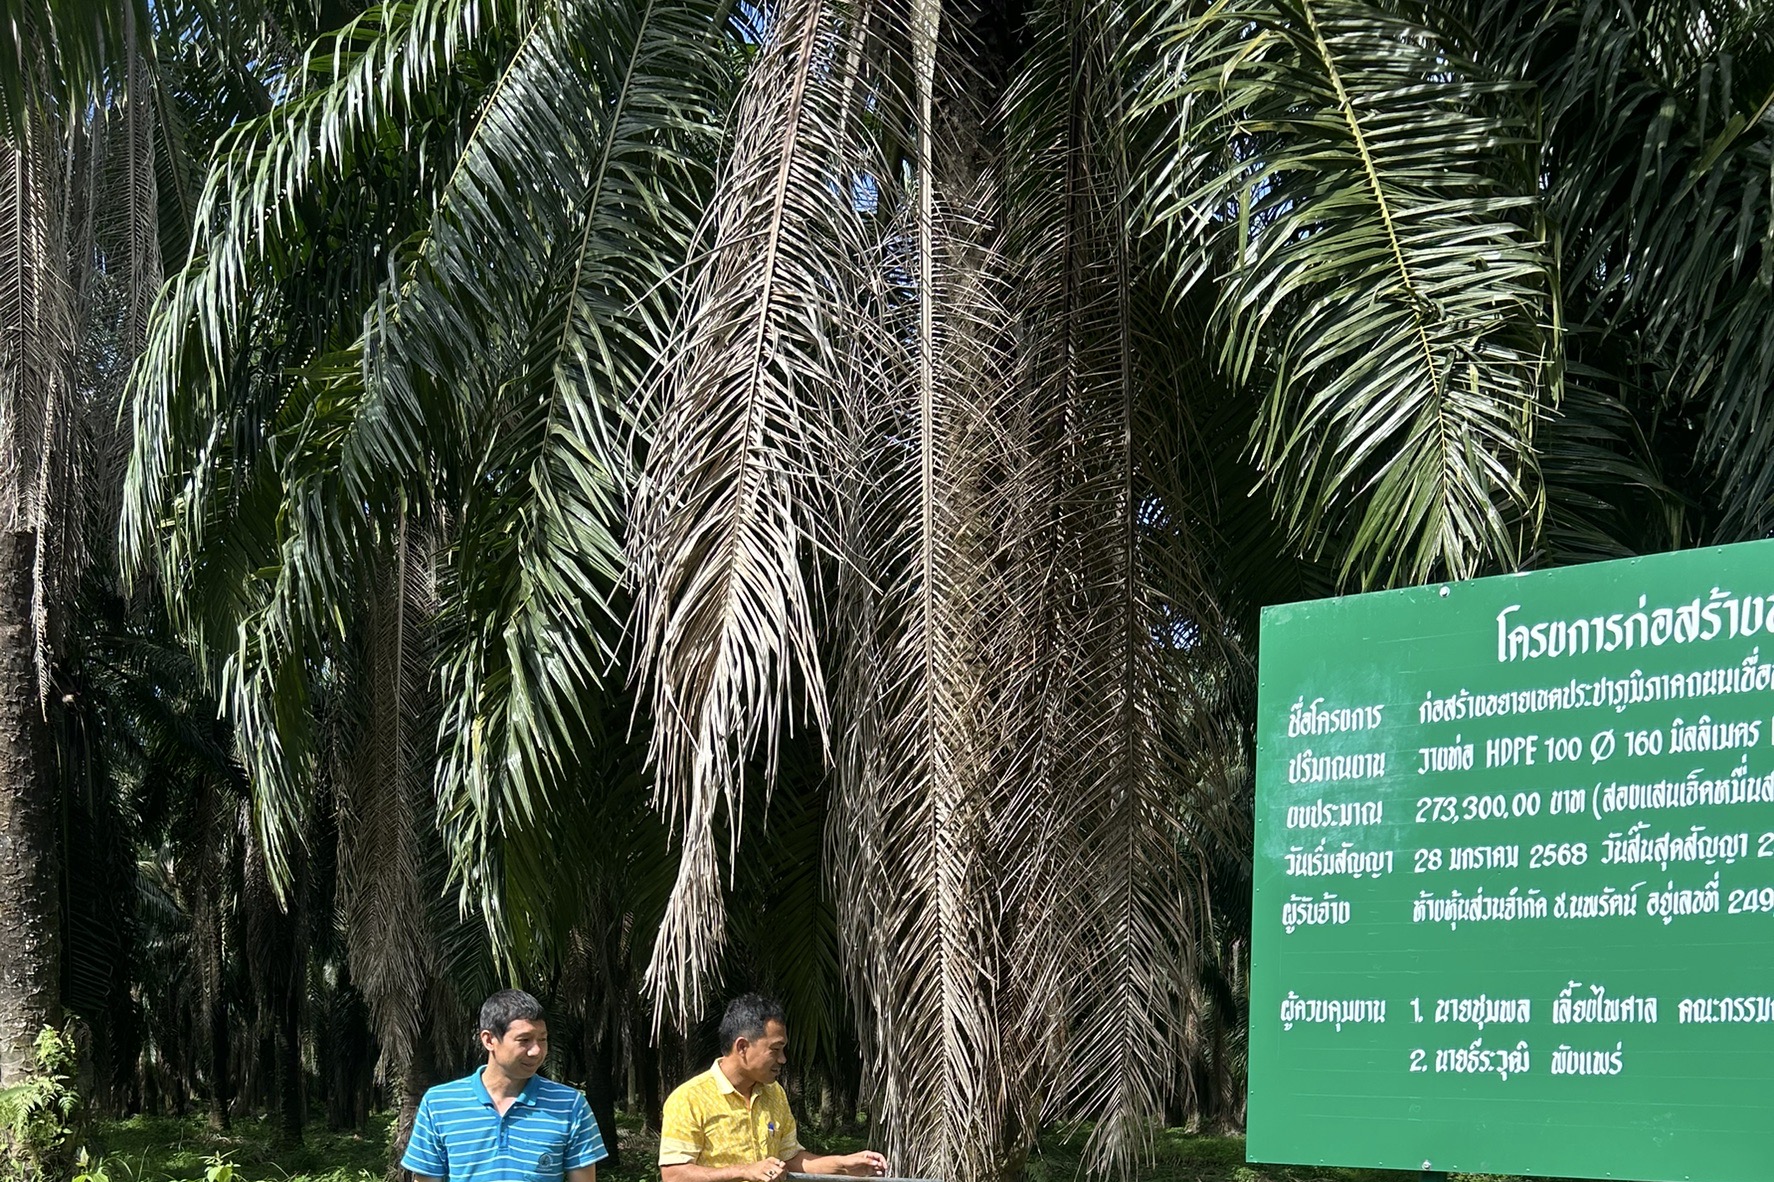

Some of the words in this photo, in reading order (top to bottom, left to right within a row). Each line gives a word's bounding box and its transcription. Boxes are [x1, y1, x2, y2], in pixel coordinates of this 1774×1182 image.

[1287, 695, 1385, 738] ชื่อโครงการ
[1418, 646, 1774, 725] ก่อสร้างขยายเขตประปาภูมิภาคถนนเขื่อ
[1288, 747, 1386, 785] ปริมาณงาน
[1417, 741, 1474, 775] วางท่อ
[1486, 735, 1539, 769] HDPE
[1543, 736, 1581, 763] 100
[1623, 729, 1663, 757] 160
[1668, 715, 1760, 755] มิลลิเมตร
[1286, 798, 1383, 829] งบประมาณ
[1415, 791, 1541, 824] 273,300.00
[1549, 789, 1586, 815] บาท
[1283, 837, 1394, 879] วันเริ่มสัญญา
[1414, 848, 1443, 874] 28
[1448, 845, 1519, 871] มกราคม
[1529, 842, 1588, 869] 2568
[1600, 820, 1749, 871] วันสิ้นสุดสัญญา
[1281, 891, 1351, 935] ผู้รับจ้าง
[1412, 886, 1548, 931] ห้างหุ้นส่วนจำกัด
[1553, 881, 1648, 920] ช.นพรัตน์
[1646, 871, 1721, 926] อยู่เลขที่
[1280, 990, 1386, 1033] ผู้ควบคุมงาน
[1409, 997, 1424, 1023] 1.
[1434, 993, 1531, 1031] นายชุมพล
[1552, 980, 1658, 1024] เลี้ยงไพศาล
[1677, 995, 1774, 1024] คณะกรรม
[1409, 1048, 1428, 1073] 2.
[1435, 1037, 1530, 1082] นายธีระวุฒิ
[1550, 1041, 1623, 1076] พังแพร่
